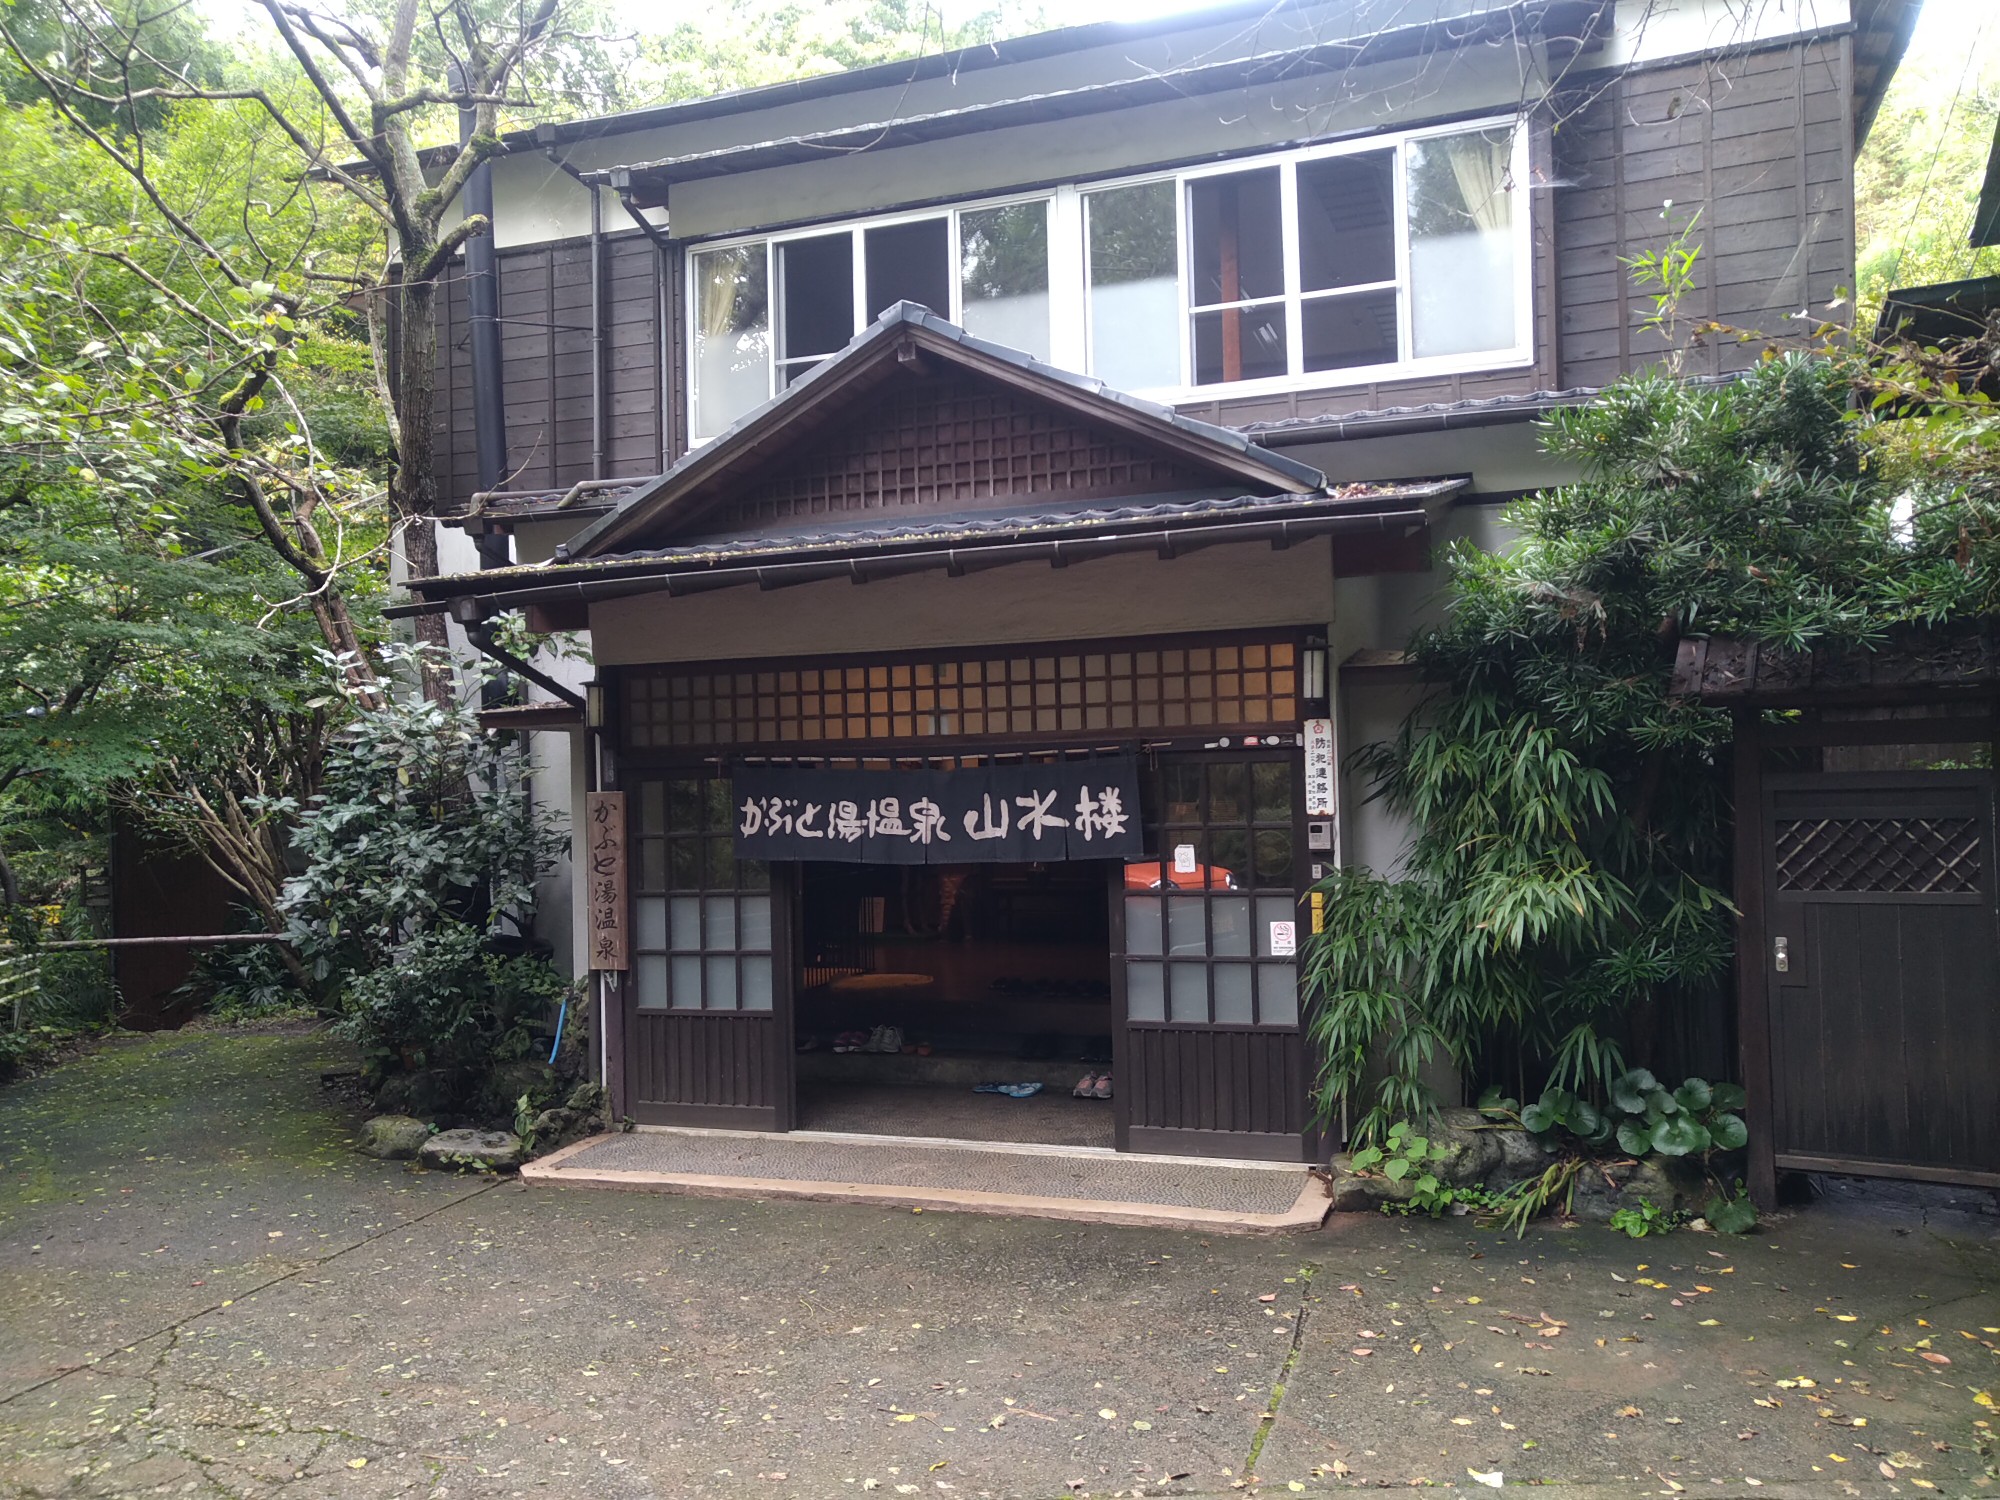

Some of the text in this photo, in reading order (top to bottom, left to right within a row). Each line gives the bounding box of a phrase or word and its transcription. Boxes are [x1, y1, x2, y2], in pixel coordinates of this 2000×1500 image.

[1315, 737, 1329, 809] 防犯連絡所
[740, 785, 1130, 845] かぶと湯温泉 山水楼
[593, 800, 618, 961] かぶと湯温泉
